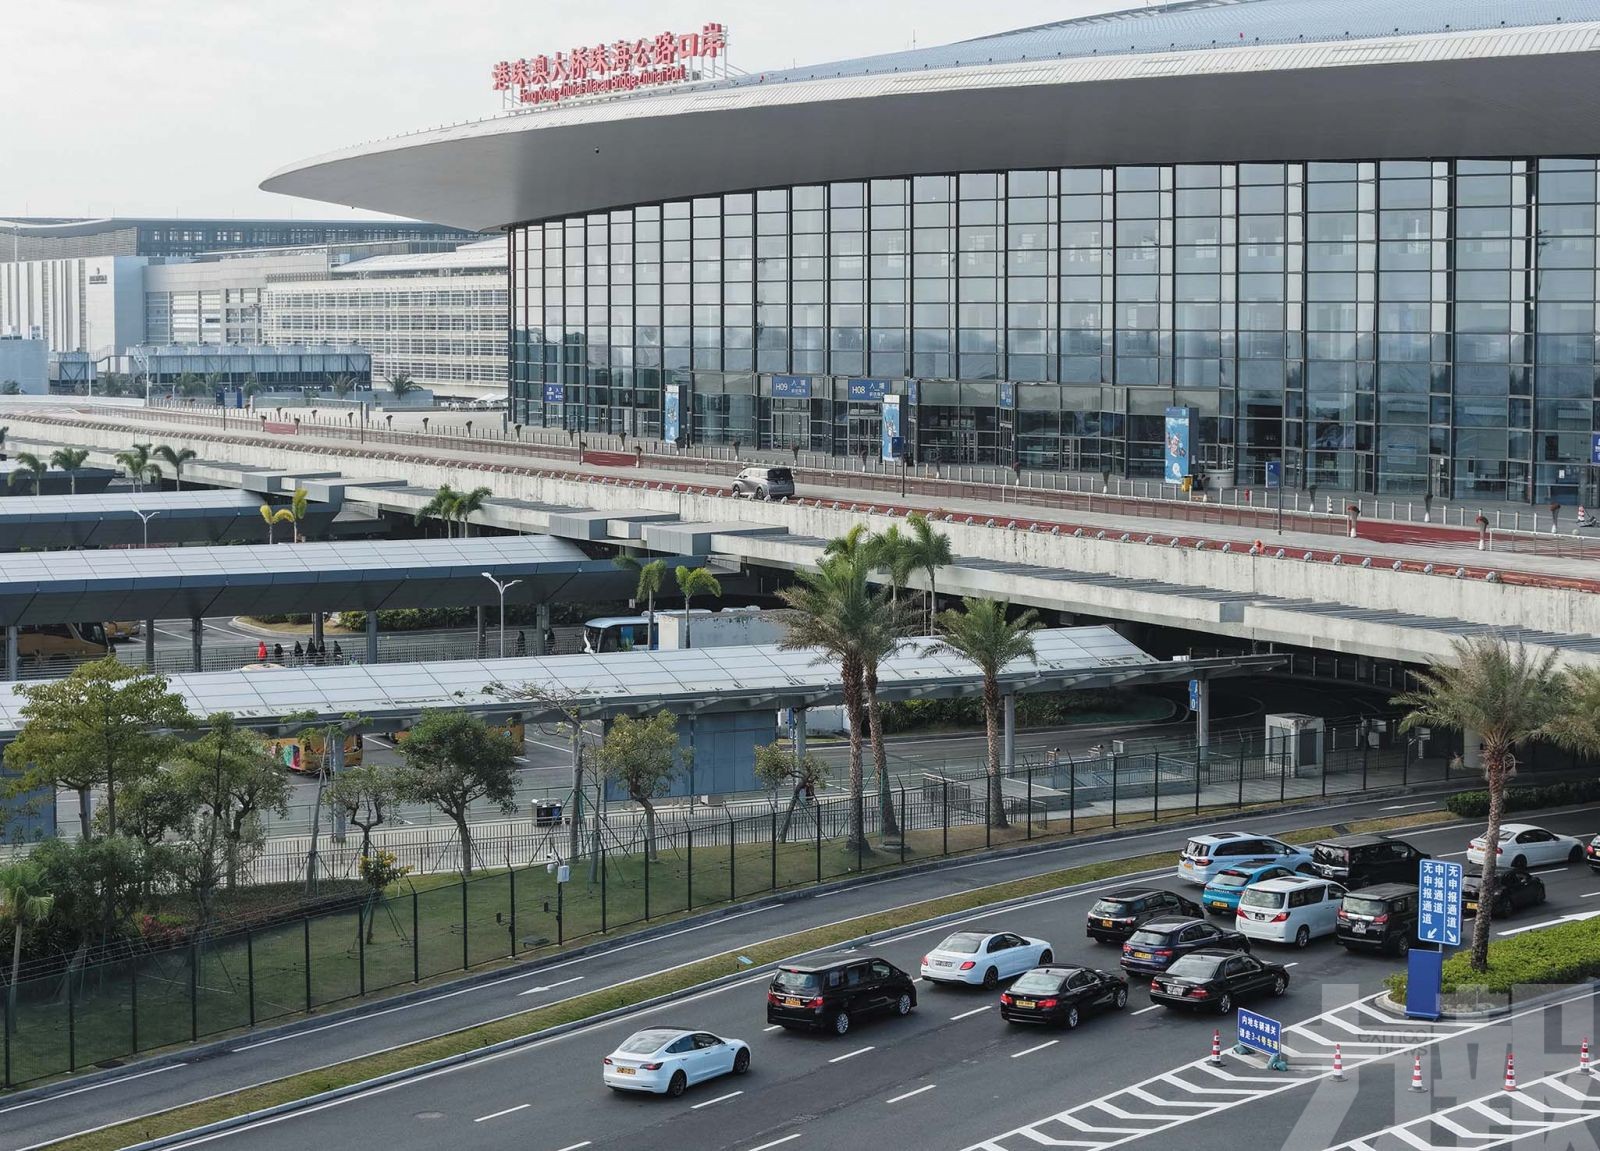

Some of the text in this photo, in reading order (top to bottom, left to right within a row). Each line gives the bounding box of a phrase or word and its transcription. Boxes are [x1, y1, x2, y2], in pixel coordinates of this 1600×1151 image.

[492, 23, 726, 91] 港珠澳大桥珠海公路口岸
[520, 88, 539, 104] Hong
[1422, 863, 1433, 925] 无申报通道
[1433, 864, 1444, 914] 申报通道
[1446, 865, 1459, 928] 无申报通道
[1239, 1027, 1279, 1051] 请走3-4号车道
[1241, 1015, 1276, 1036] 内地车辆通关
